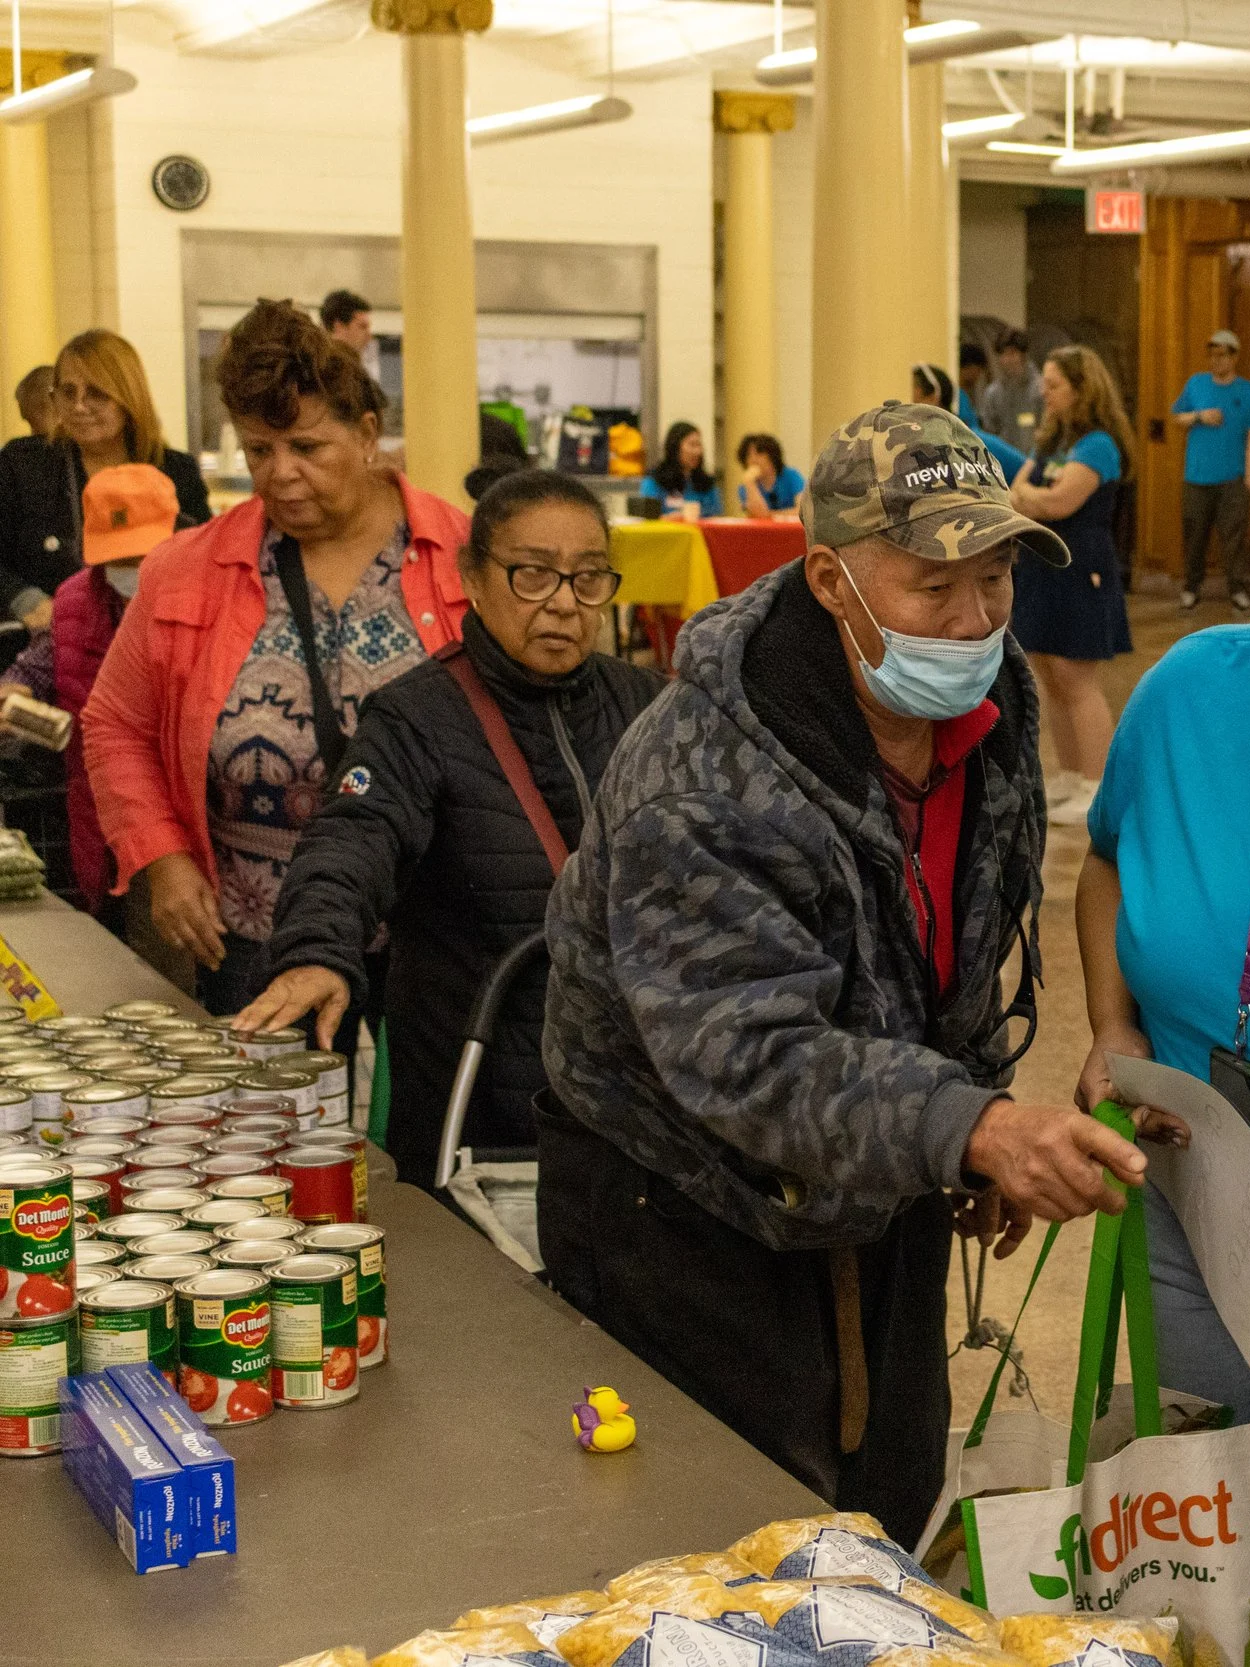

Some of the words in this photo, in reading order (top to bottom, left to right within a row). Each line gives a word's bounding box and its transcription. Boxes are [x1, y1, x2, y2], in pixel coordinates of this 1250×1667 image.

[905, 464, 949, 488] new
[953, 460, 991, 480] york
[18, 1213, 38, 1226] Del
[40, 1206, 70, 1224] Monte
[22, 1248, 70, 1267] Sauce
[199, 1313, 219, 1321] VINE
[227, 1321, 247, 1335] Del
[231, 1353, 271, 1375] Sauce
[211, 1471, 224, 1509] RONZONI
[163, 1484, 176, 1522] RONZONI
[1098, 1559, 1162, 1612] delivers
